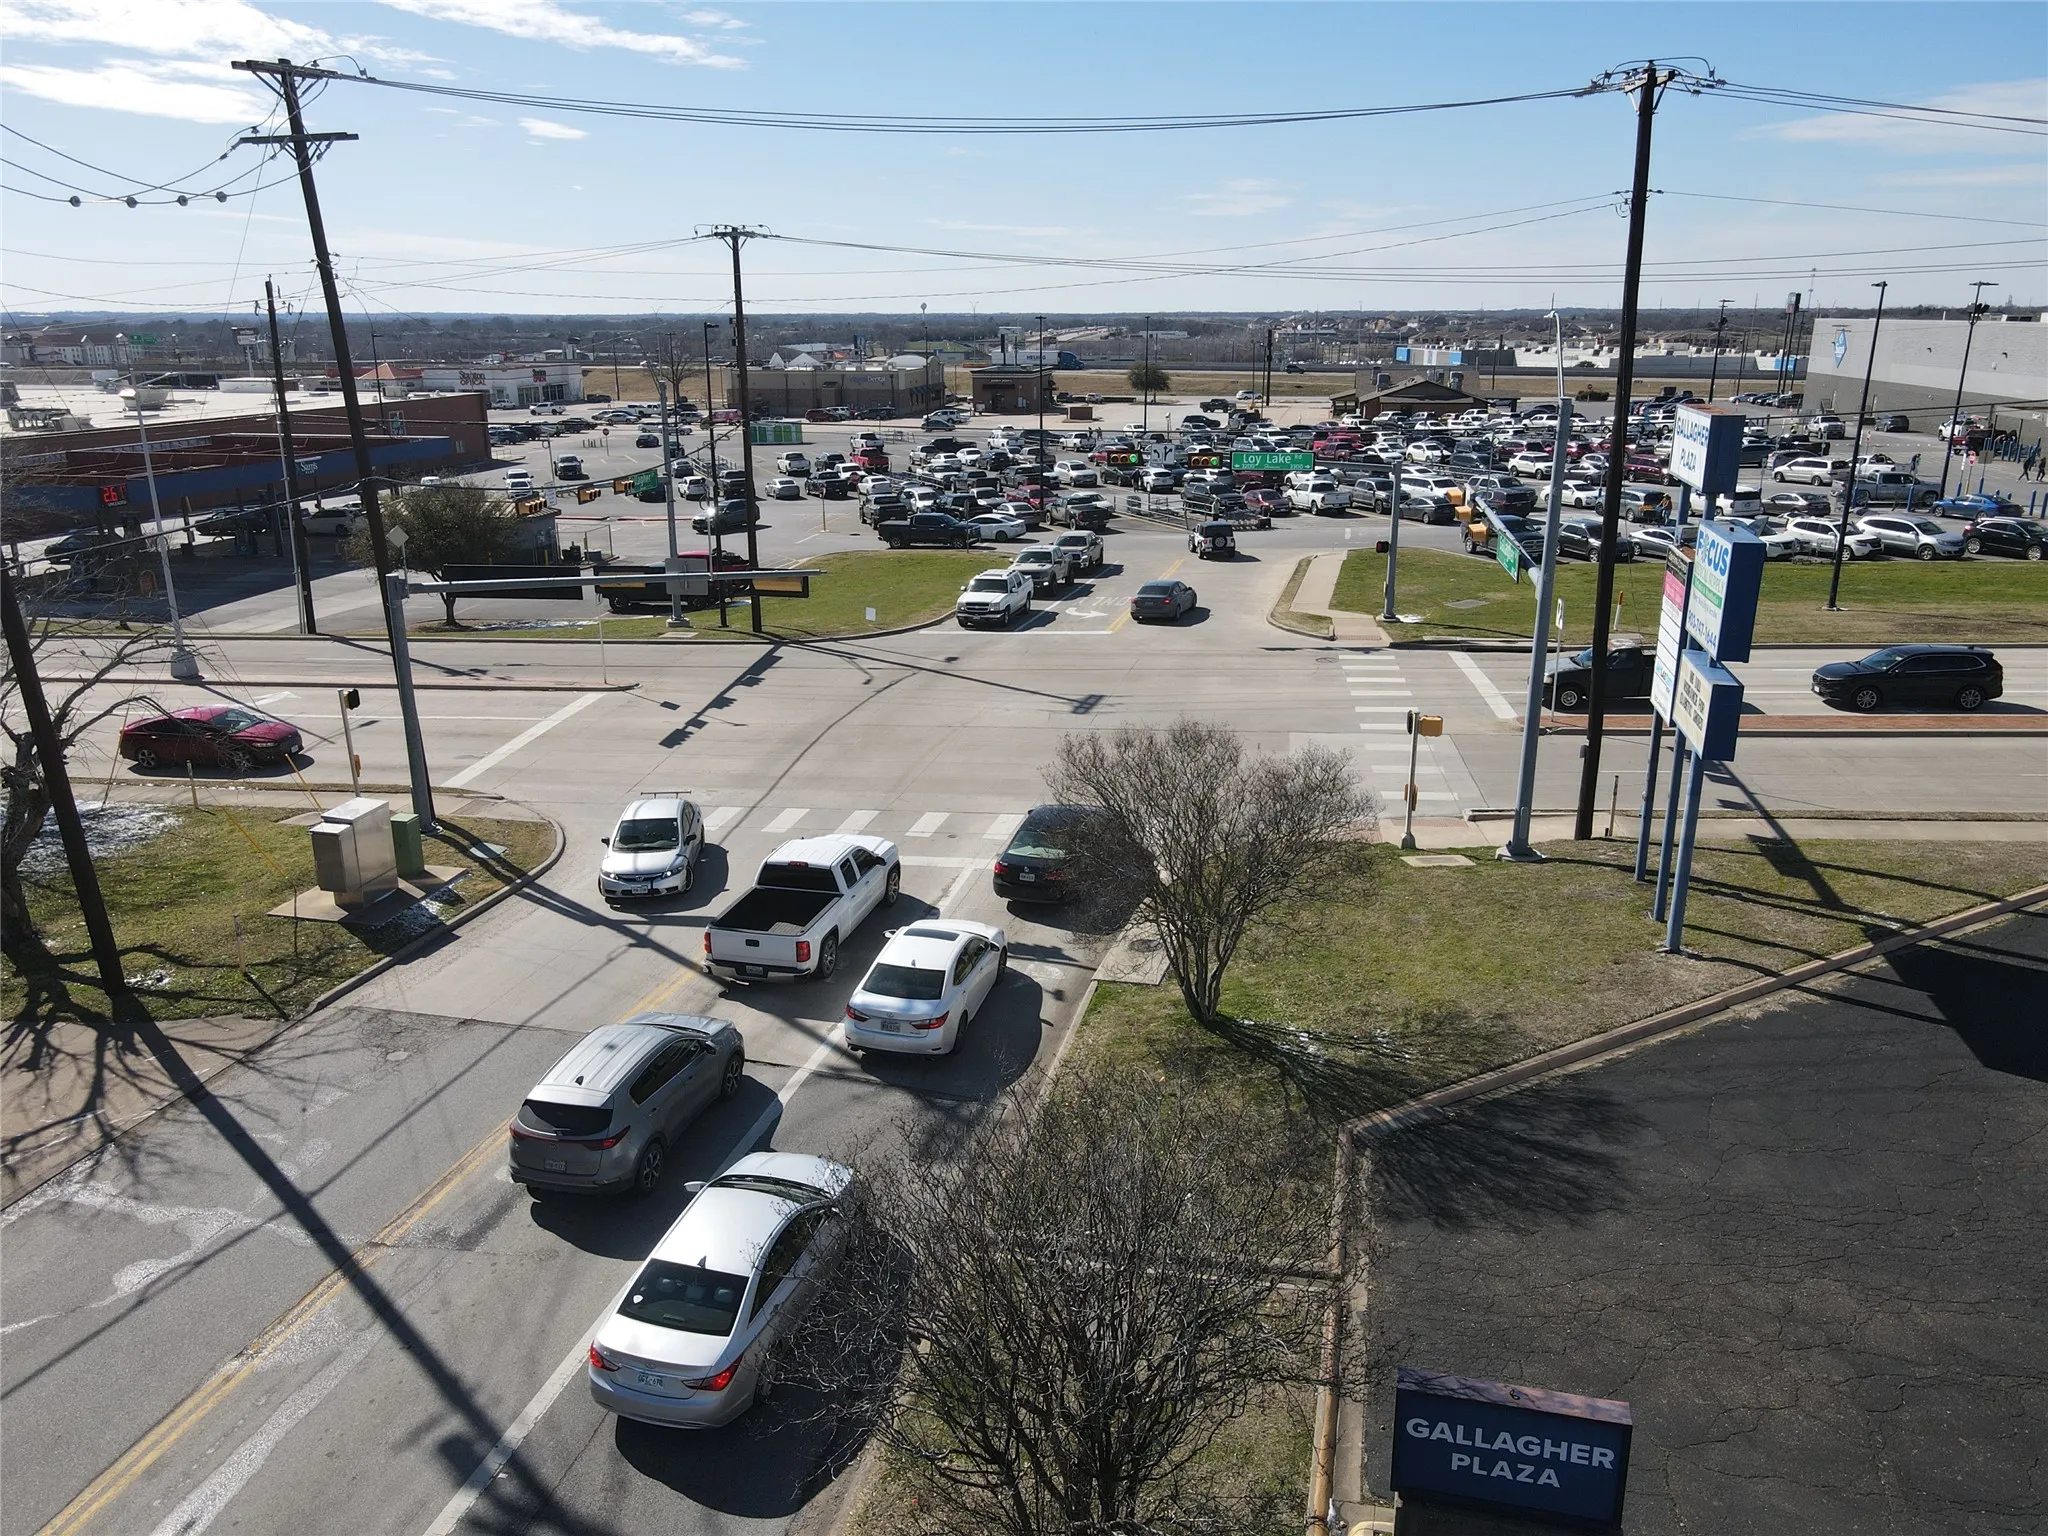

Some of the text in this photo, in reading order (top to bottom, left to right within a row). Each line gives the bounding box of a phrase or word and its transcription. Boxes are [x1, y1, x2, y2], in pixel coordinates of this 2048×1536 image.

[1677, 417, 1708, 448] GALLAGHER
[1243, 455, 1261, 466] Loy
[1266, 454, 1291, 464] Lake
[1681, 448, 1696, 472] PLAZA
[1405, 1417, 1615, 1469] GALLAGHER
[1451, 1453, 1561, 1488] PLAZA
